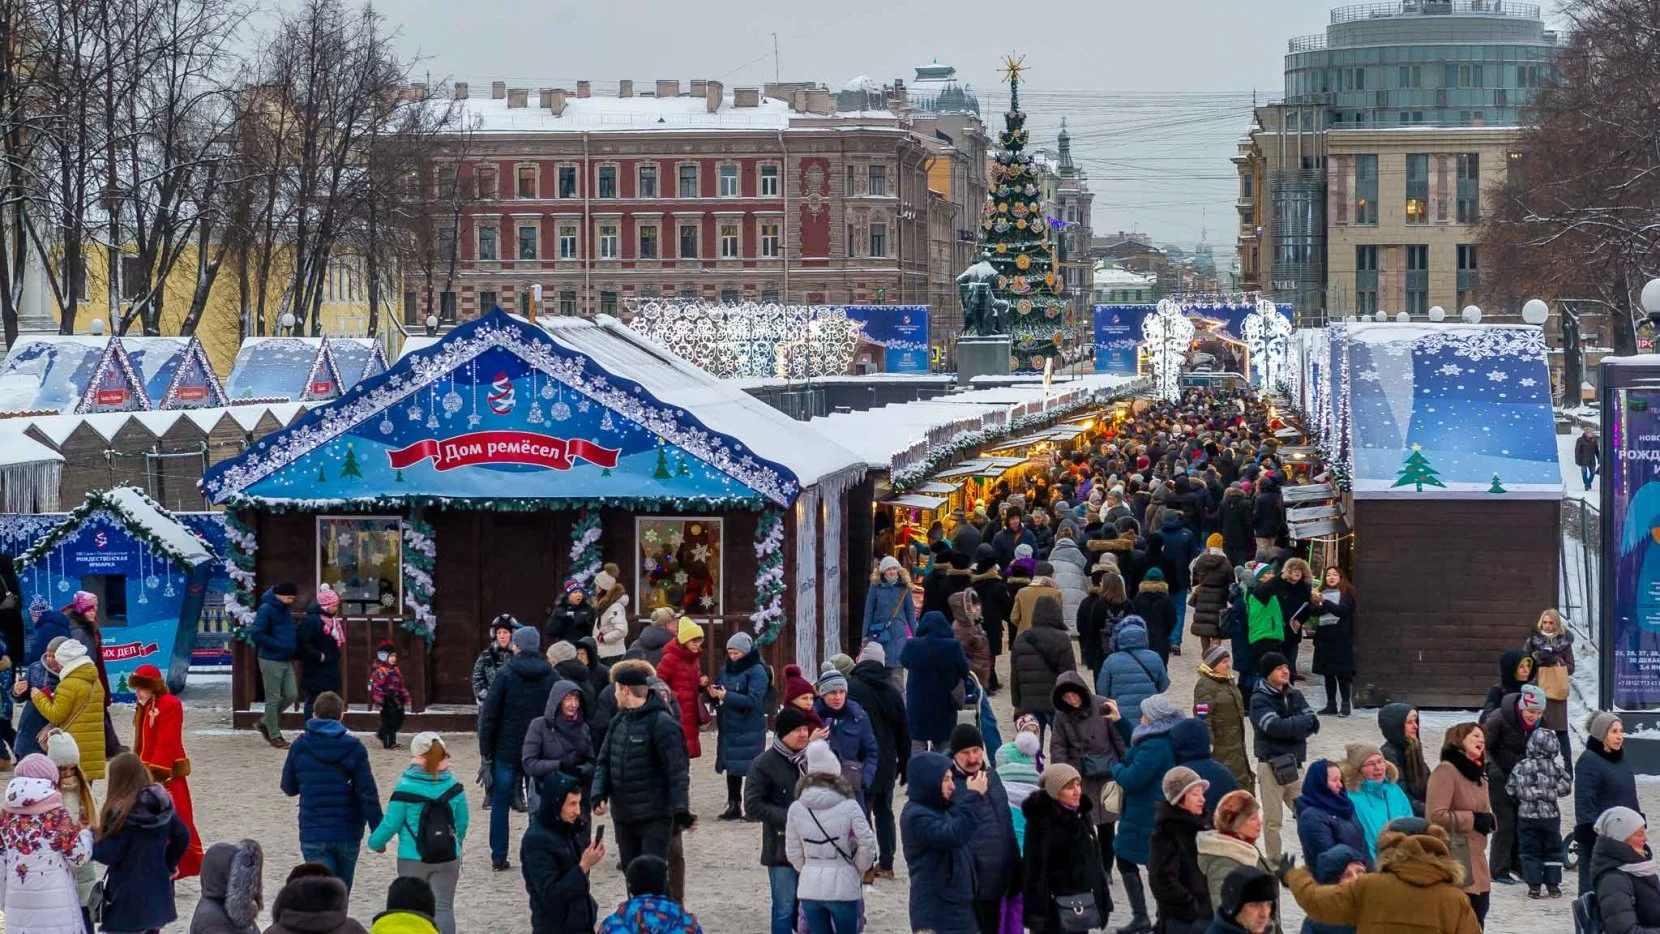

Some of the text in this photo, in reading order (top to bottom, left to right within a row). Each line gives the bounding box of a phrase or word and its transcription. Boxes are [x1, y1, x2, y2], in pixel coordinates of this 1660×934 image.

[445, 439, 560, 463] Дом ремёсел
[117, 646, 137, 658] ДЕЛ
